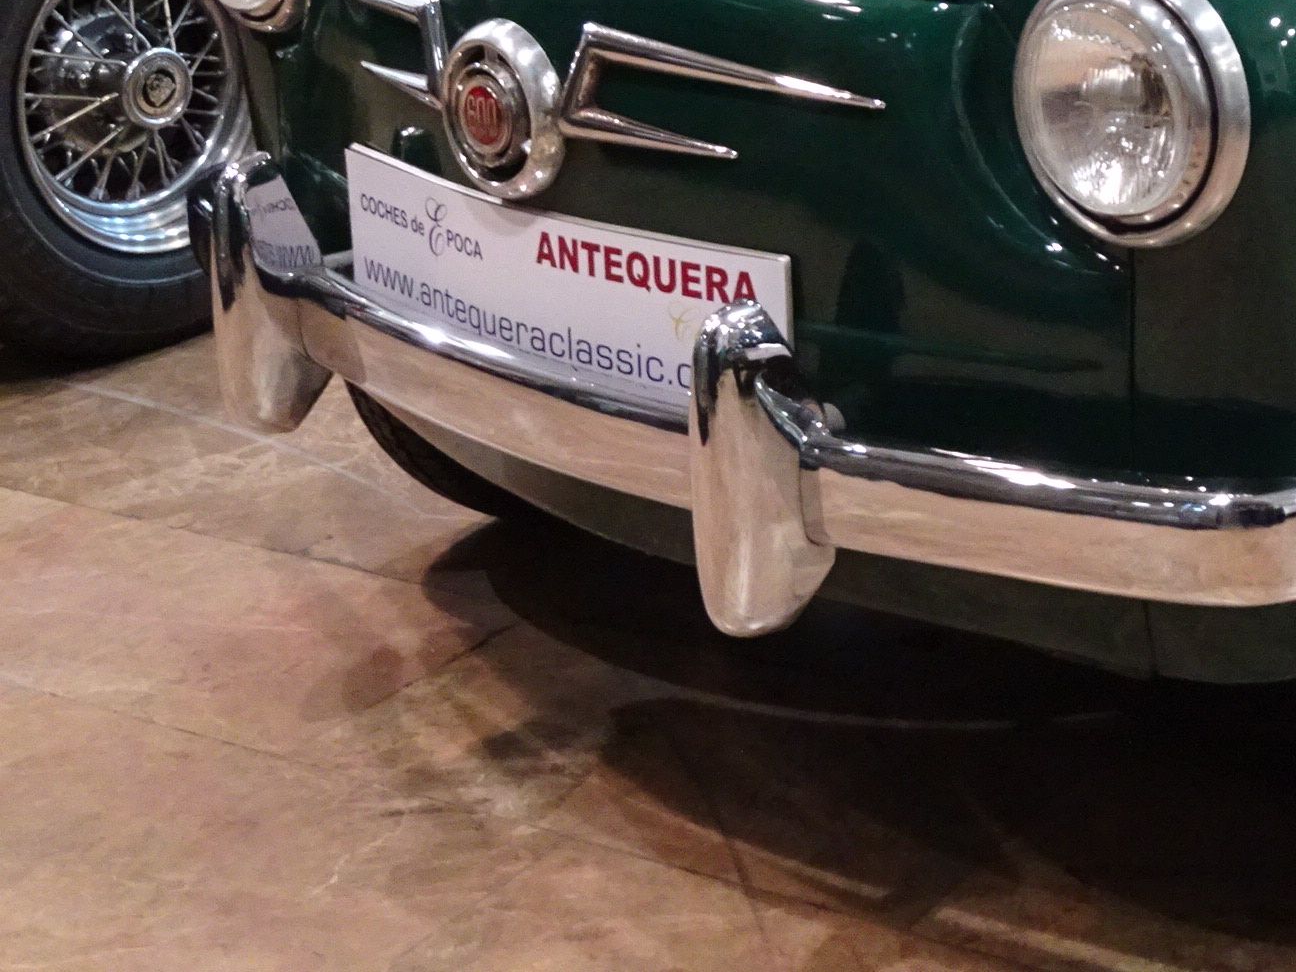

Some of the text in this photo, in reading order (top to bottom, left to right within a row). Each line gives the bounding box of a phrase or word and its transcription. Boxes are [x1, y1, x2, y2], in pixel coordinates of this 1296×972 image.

[360, 193, 408, 229] COCHES
[410, 219, 425, 237] de
[536, 231, 757, 304] ANTEQUERA
